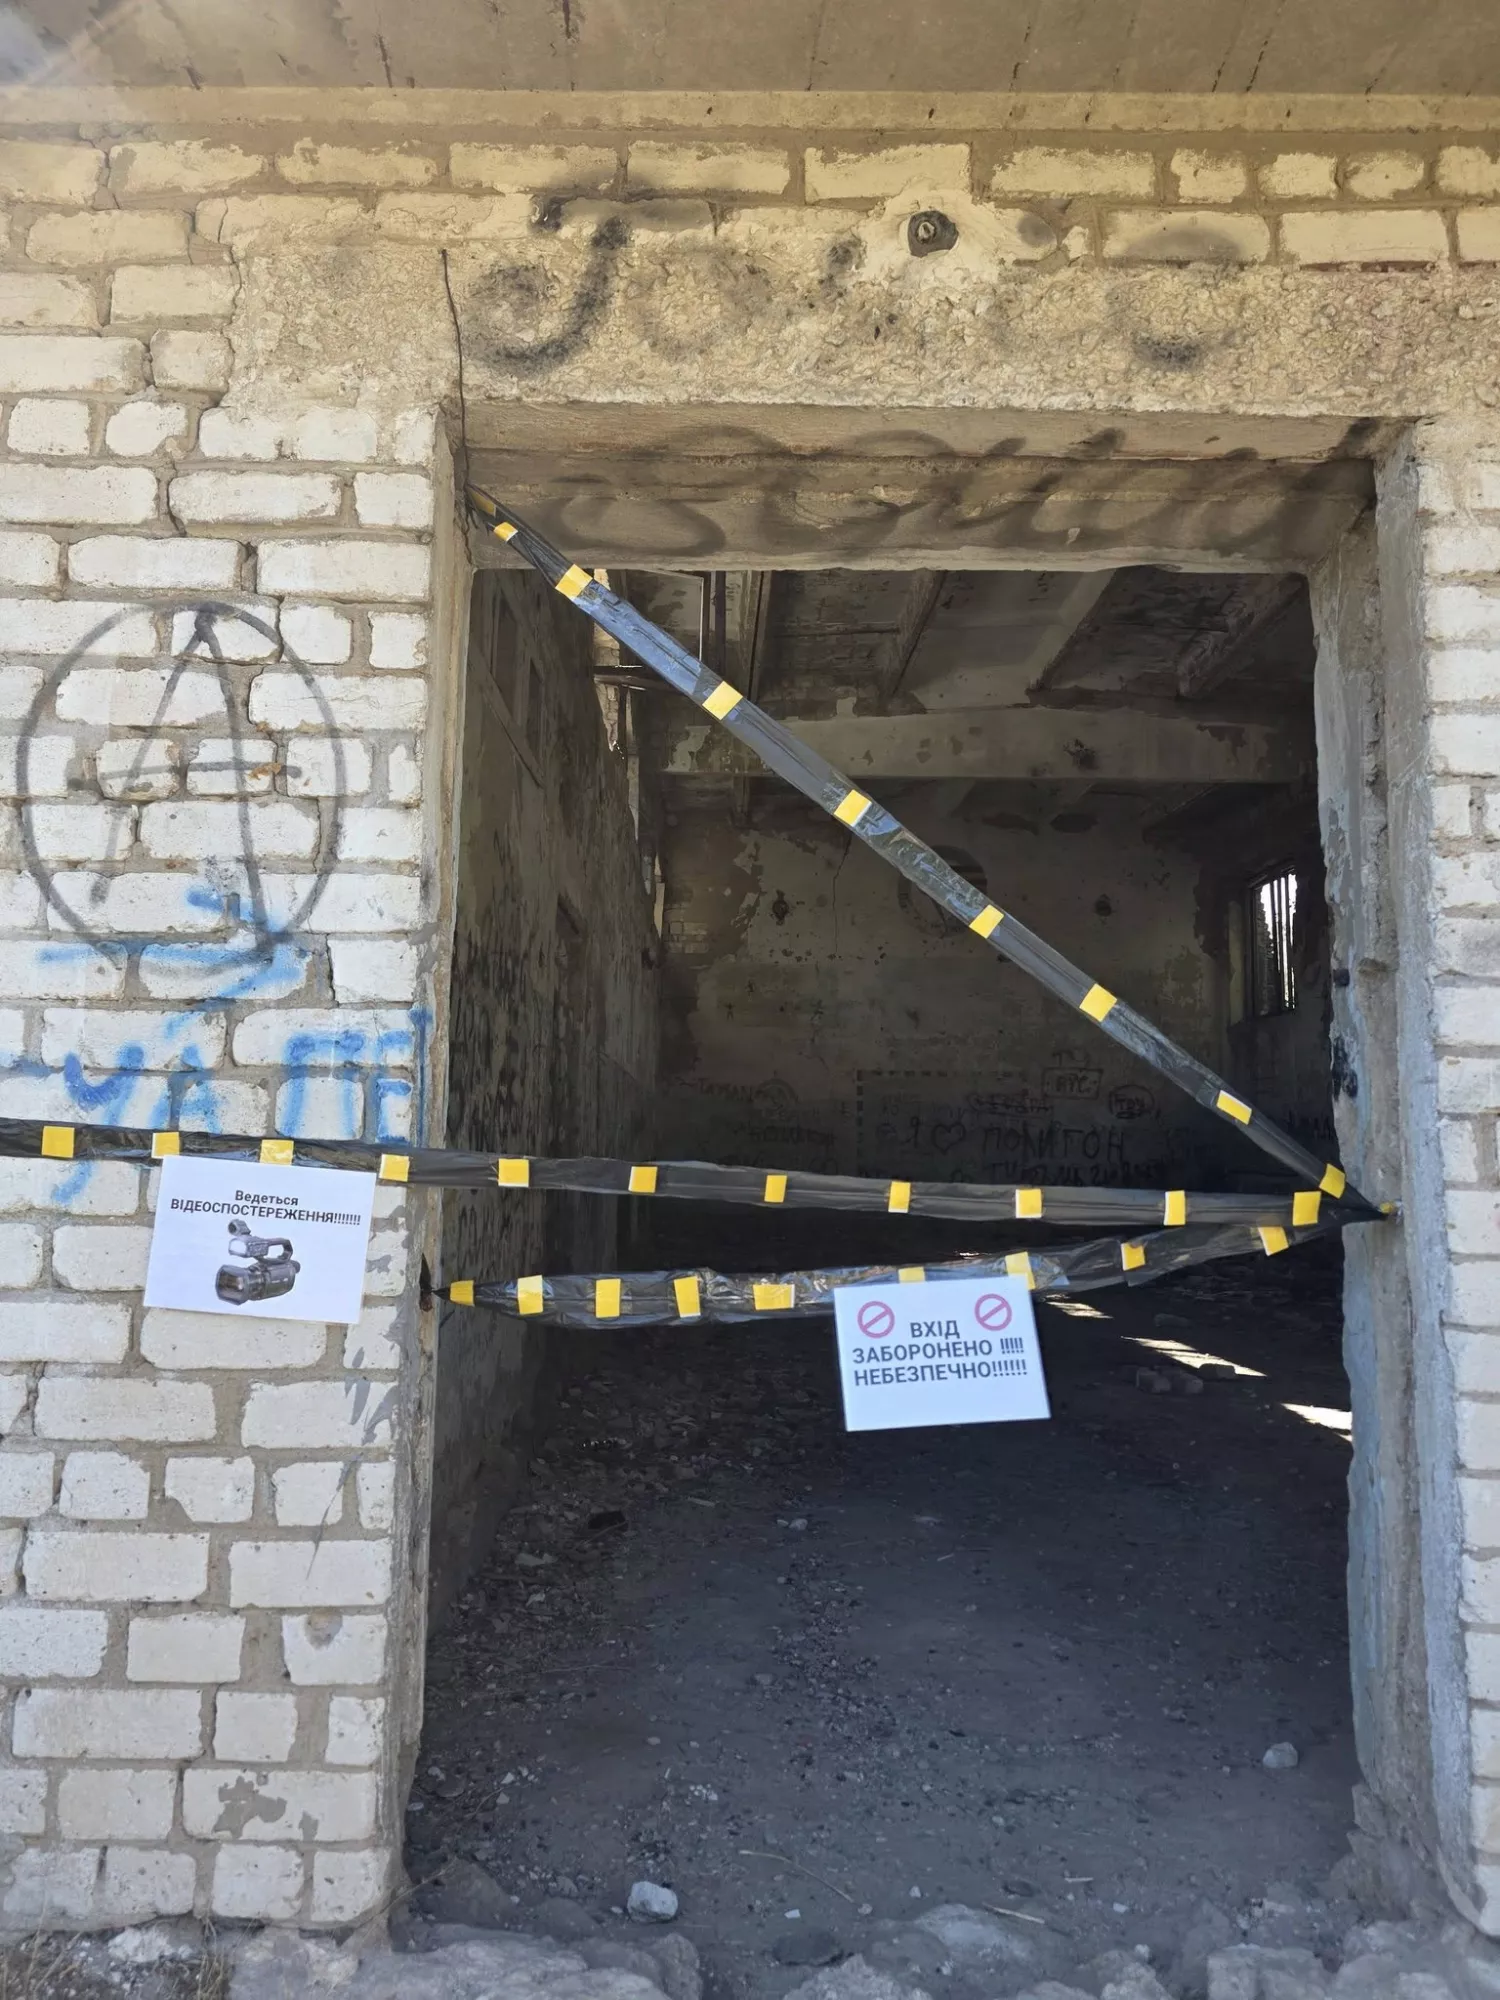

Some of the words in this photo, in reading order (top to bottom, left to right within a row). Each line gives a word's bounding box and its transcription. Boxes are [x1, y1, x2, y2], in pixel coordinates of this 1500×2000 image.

[235, 1190, 299, 1206] Ведеться
[910, 1320, 960, 1339] ВХІД
[852, 1340, 992, 1364] ЗАБОРОНЕНО
